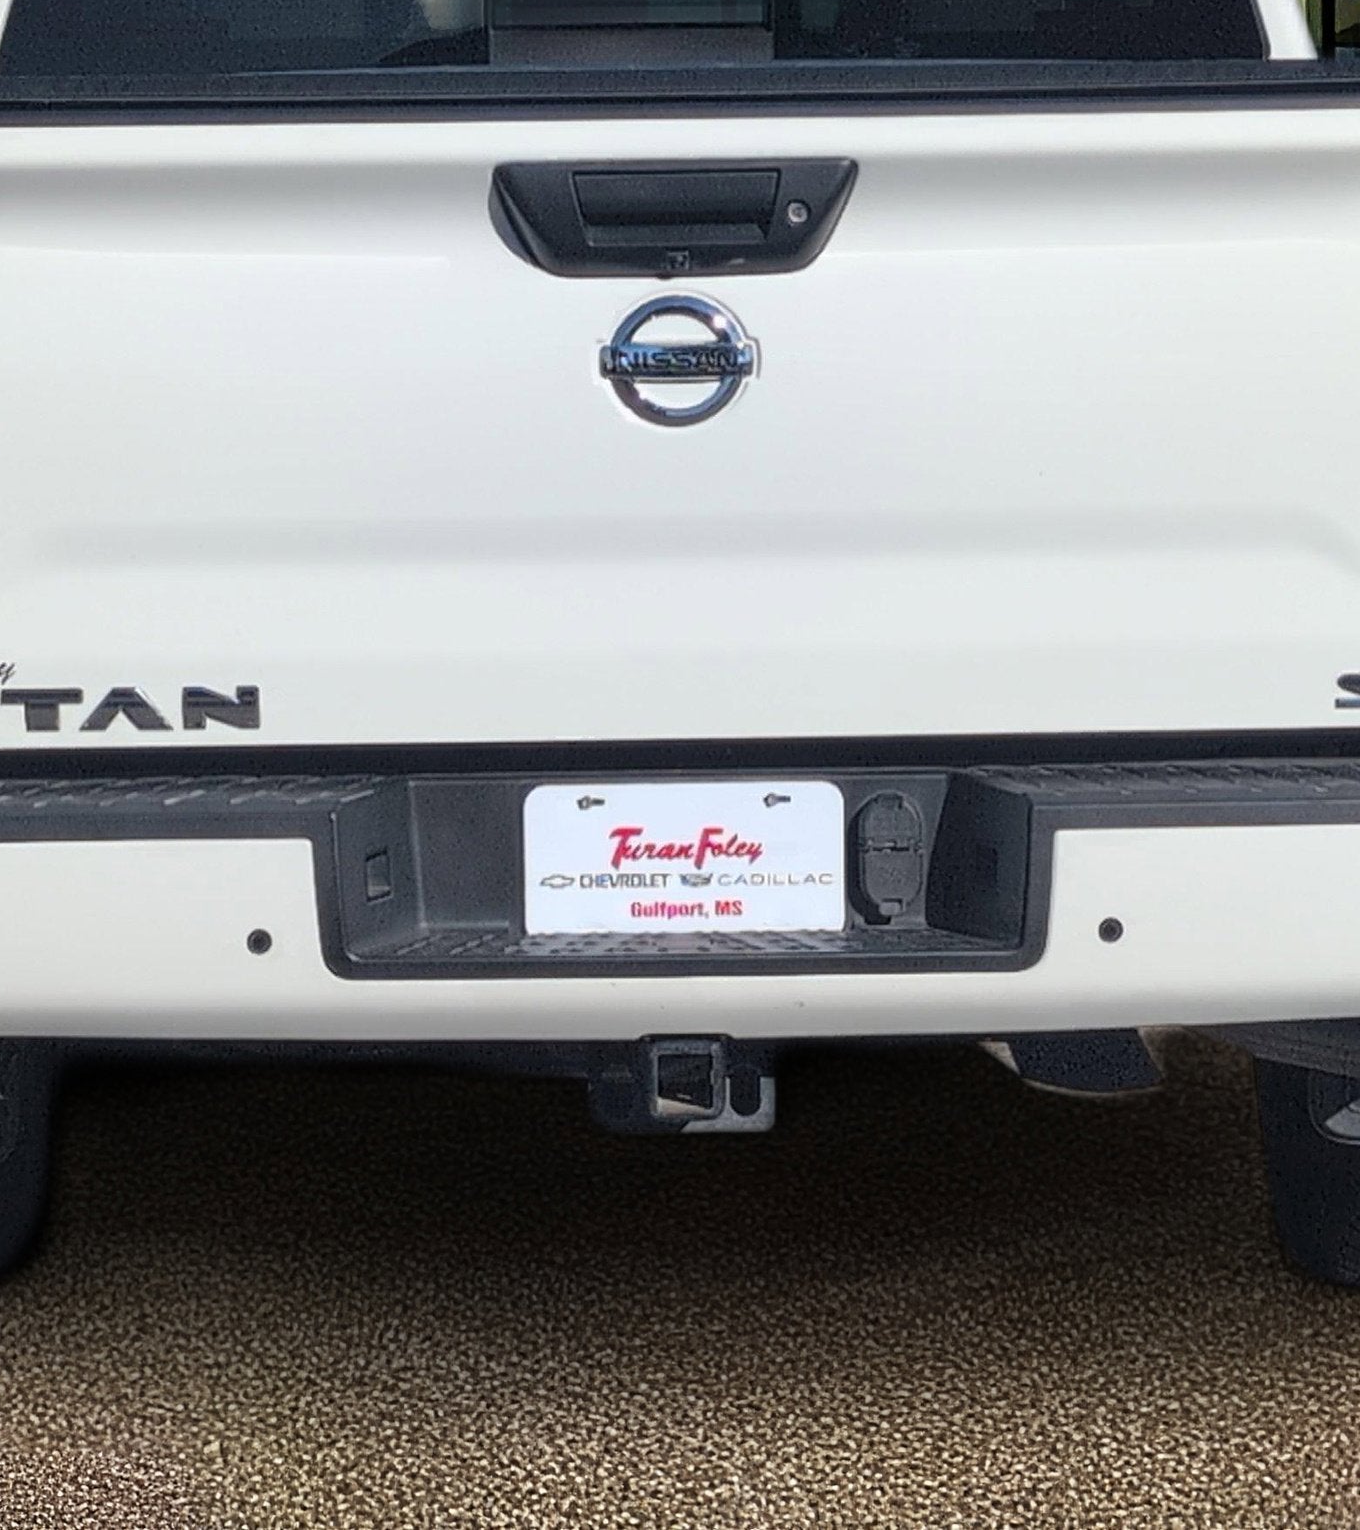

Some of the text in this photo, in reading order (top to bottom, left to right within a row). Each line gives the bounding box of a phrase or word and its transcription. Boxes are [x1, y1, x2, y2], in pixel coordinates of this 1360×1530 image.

[614, 349, 739, 373] NISSAN
[579, 872, 834, 889] CHEVROLET CADILLAC
[630, 900, 742, 919] Gulfport, MS
